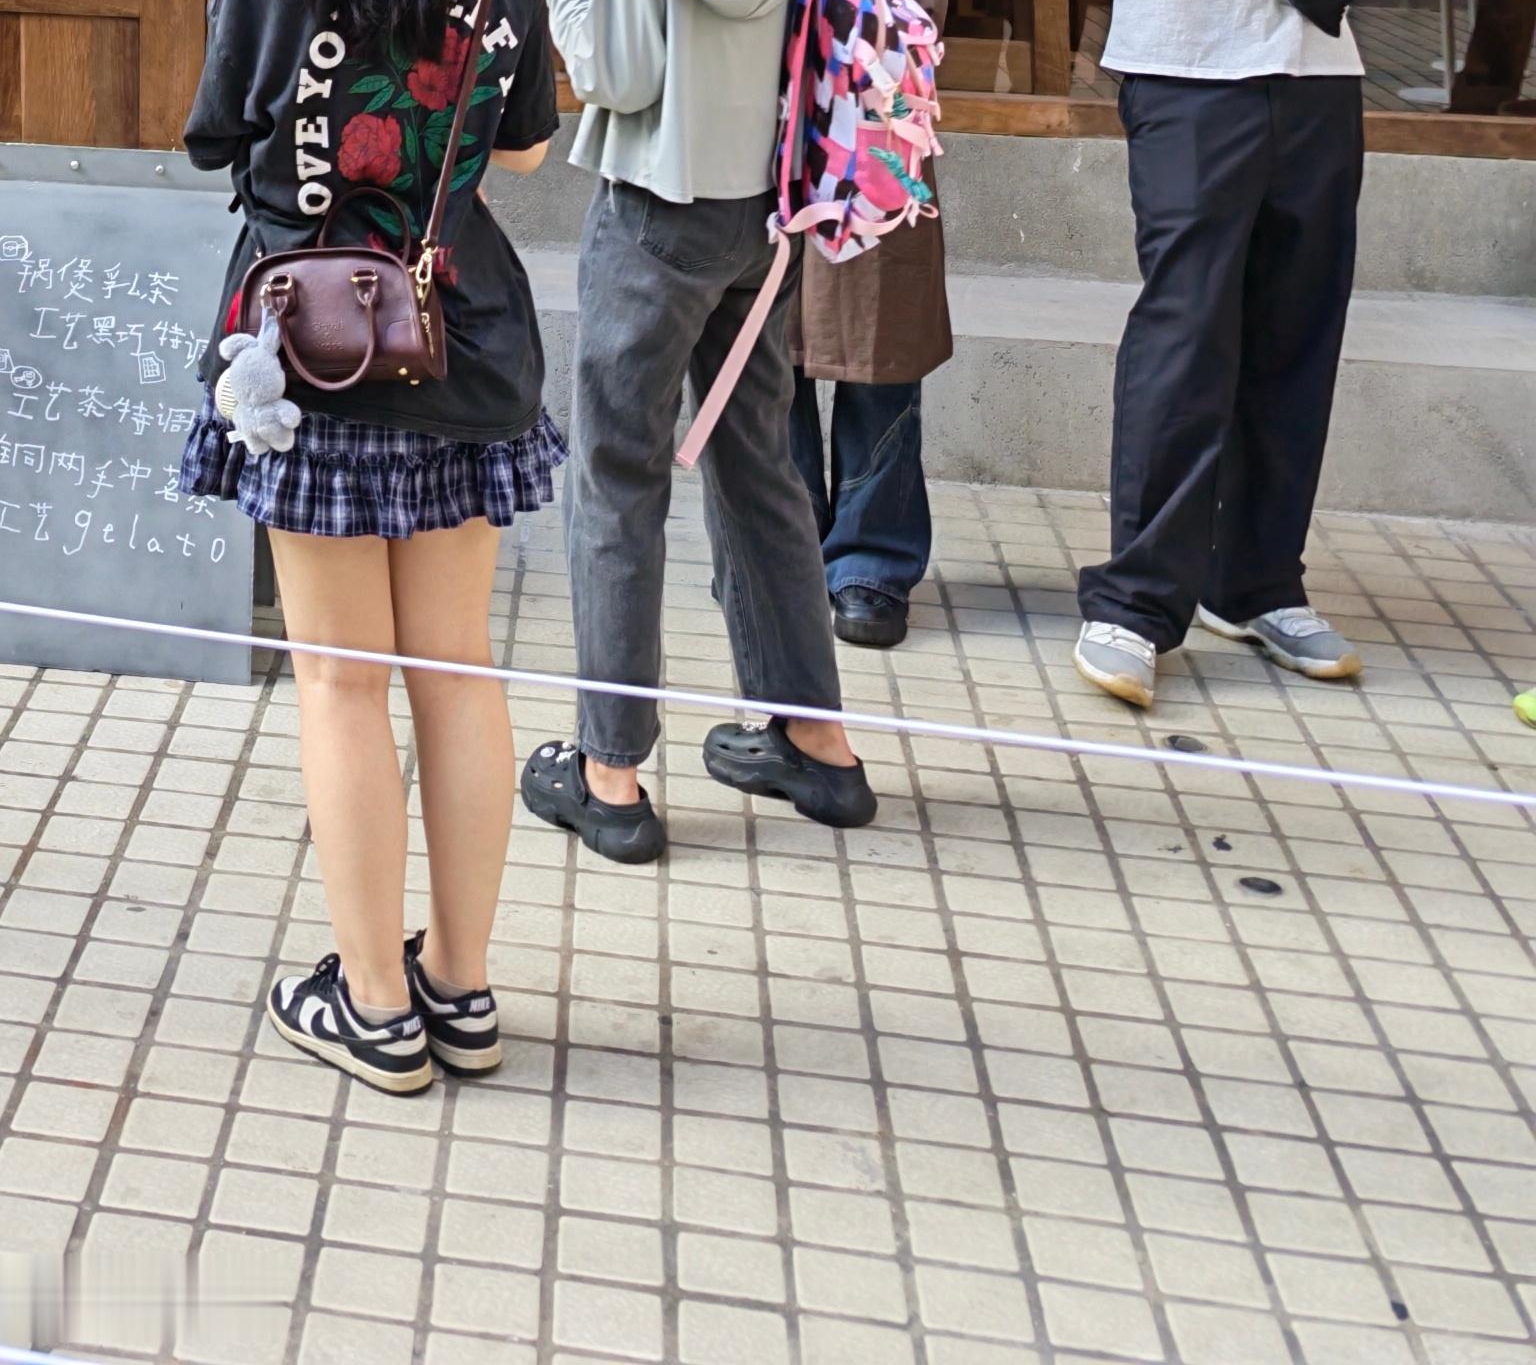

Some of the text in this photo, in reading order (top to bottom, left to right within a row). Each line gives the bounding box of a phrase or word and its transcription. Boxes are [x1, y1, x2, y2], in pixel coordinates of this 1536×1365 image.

[295, 116, 333, 216] OVE
[17, 255, 180, 306] 锅煲乳茶
[7, 382, 197, 437] 工艺茶特调
[63, 509, 226, 562] gelato
[402, 1014, 422, 1037] NIKE
[468, 996, 491, 1013] NIKE
